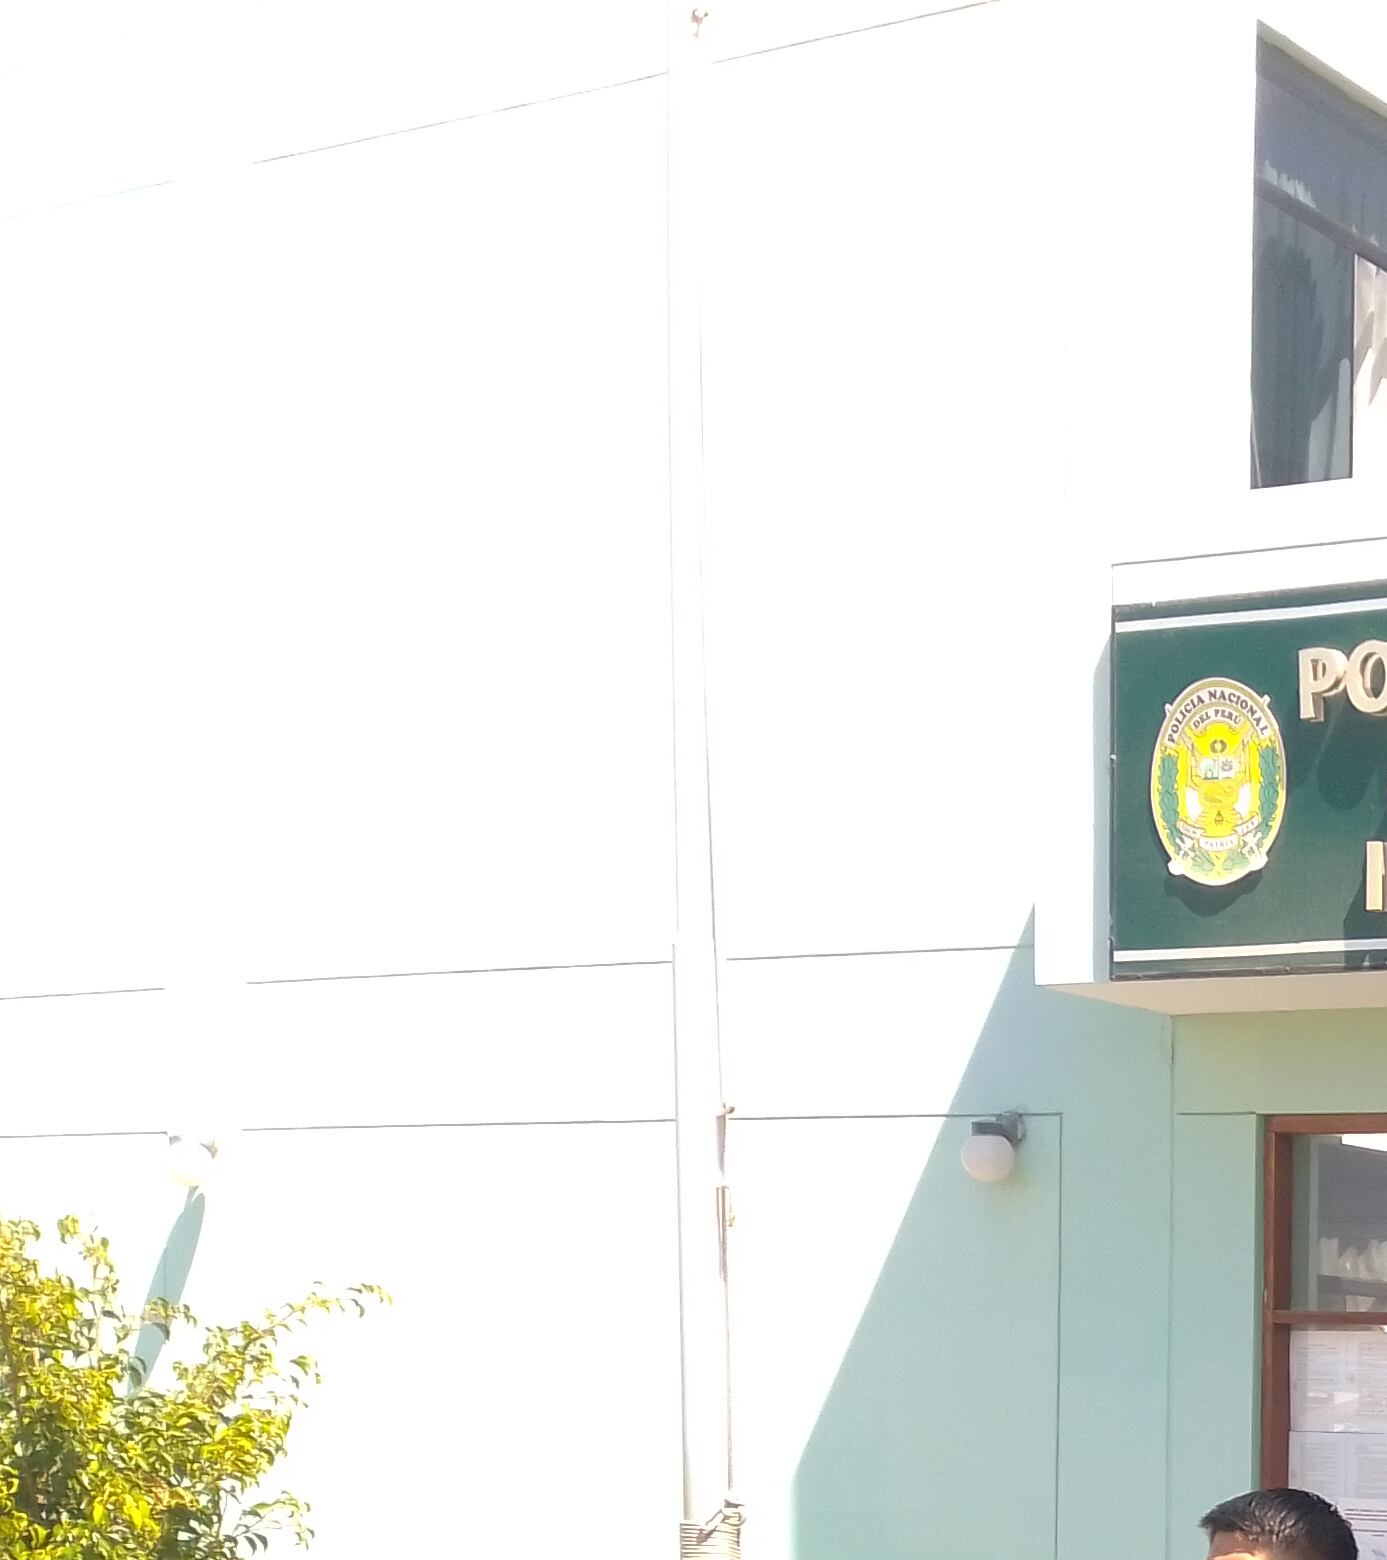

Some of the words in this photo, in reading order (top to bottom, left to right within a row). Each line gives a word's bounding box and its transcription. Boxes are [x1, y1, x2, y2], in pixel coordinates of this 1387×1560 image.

[1167, 694, 1206, 744] POLICIA
[1207, 688, 1269, 736] NACIONAL
[1193, 711, 1211, 729] DEL
